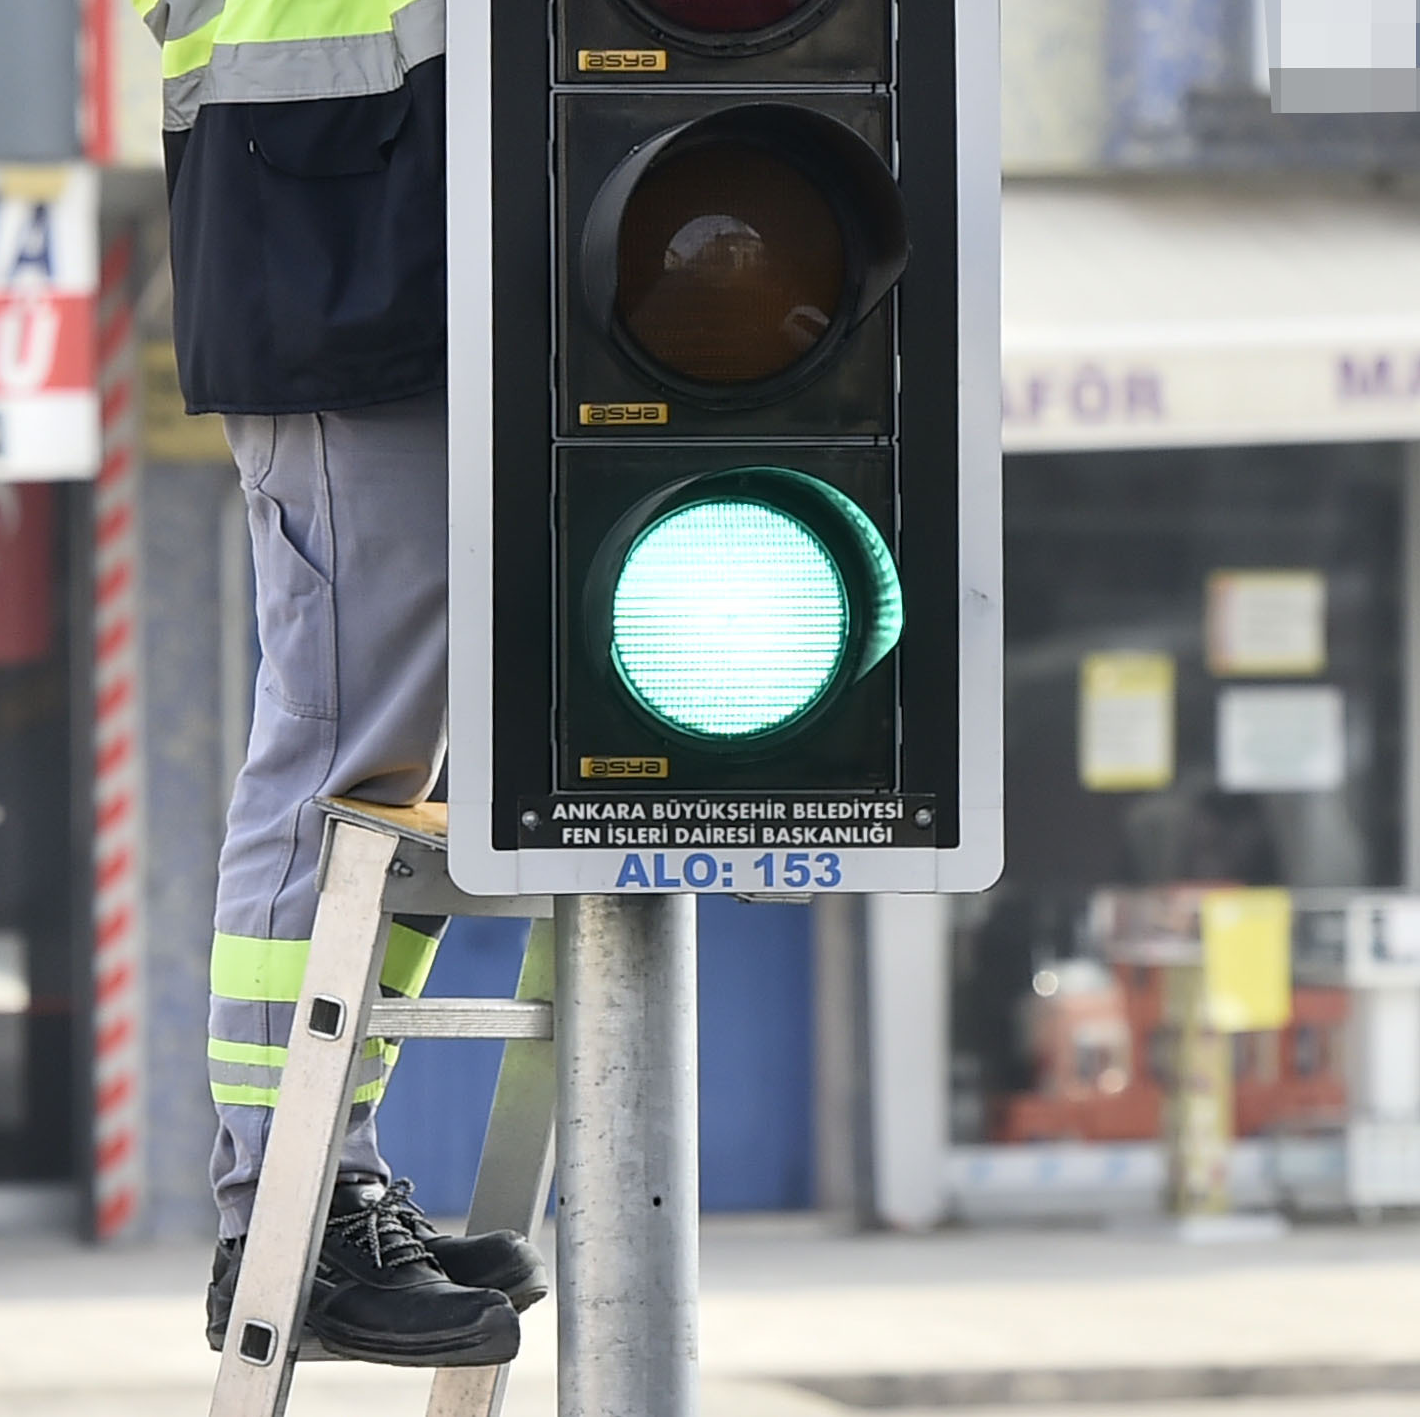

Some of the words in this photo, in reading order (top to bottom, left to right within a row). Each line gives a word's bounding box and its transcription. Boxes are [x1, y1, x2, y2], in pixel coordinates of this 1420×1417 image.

[585, 54, 657, 68] asya
[588, 406, 660, 421] asya
[590, 760, 661, 774] asya
[552, 803, 646, 820] ANKARA
[652, 799, 786, 822] BÜYÜKŞEHİR
[793, 798, 904, 819] BELEDİYESİ
[562, 827, 601, 844] FEN
[607, 823, 668, 846] İŞLERİ
[675, 823, 756, 844] DAİRESİ
[762, 822, 892, 846] BAŞKANLIĞI
[614, 852, 734, 888] ALO:
[753, 852, 843, 888] 153
